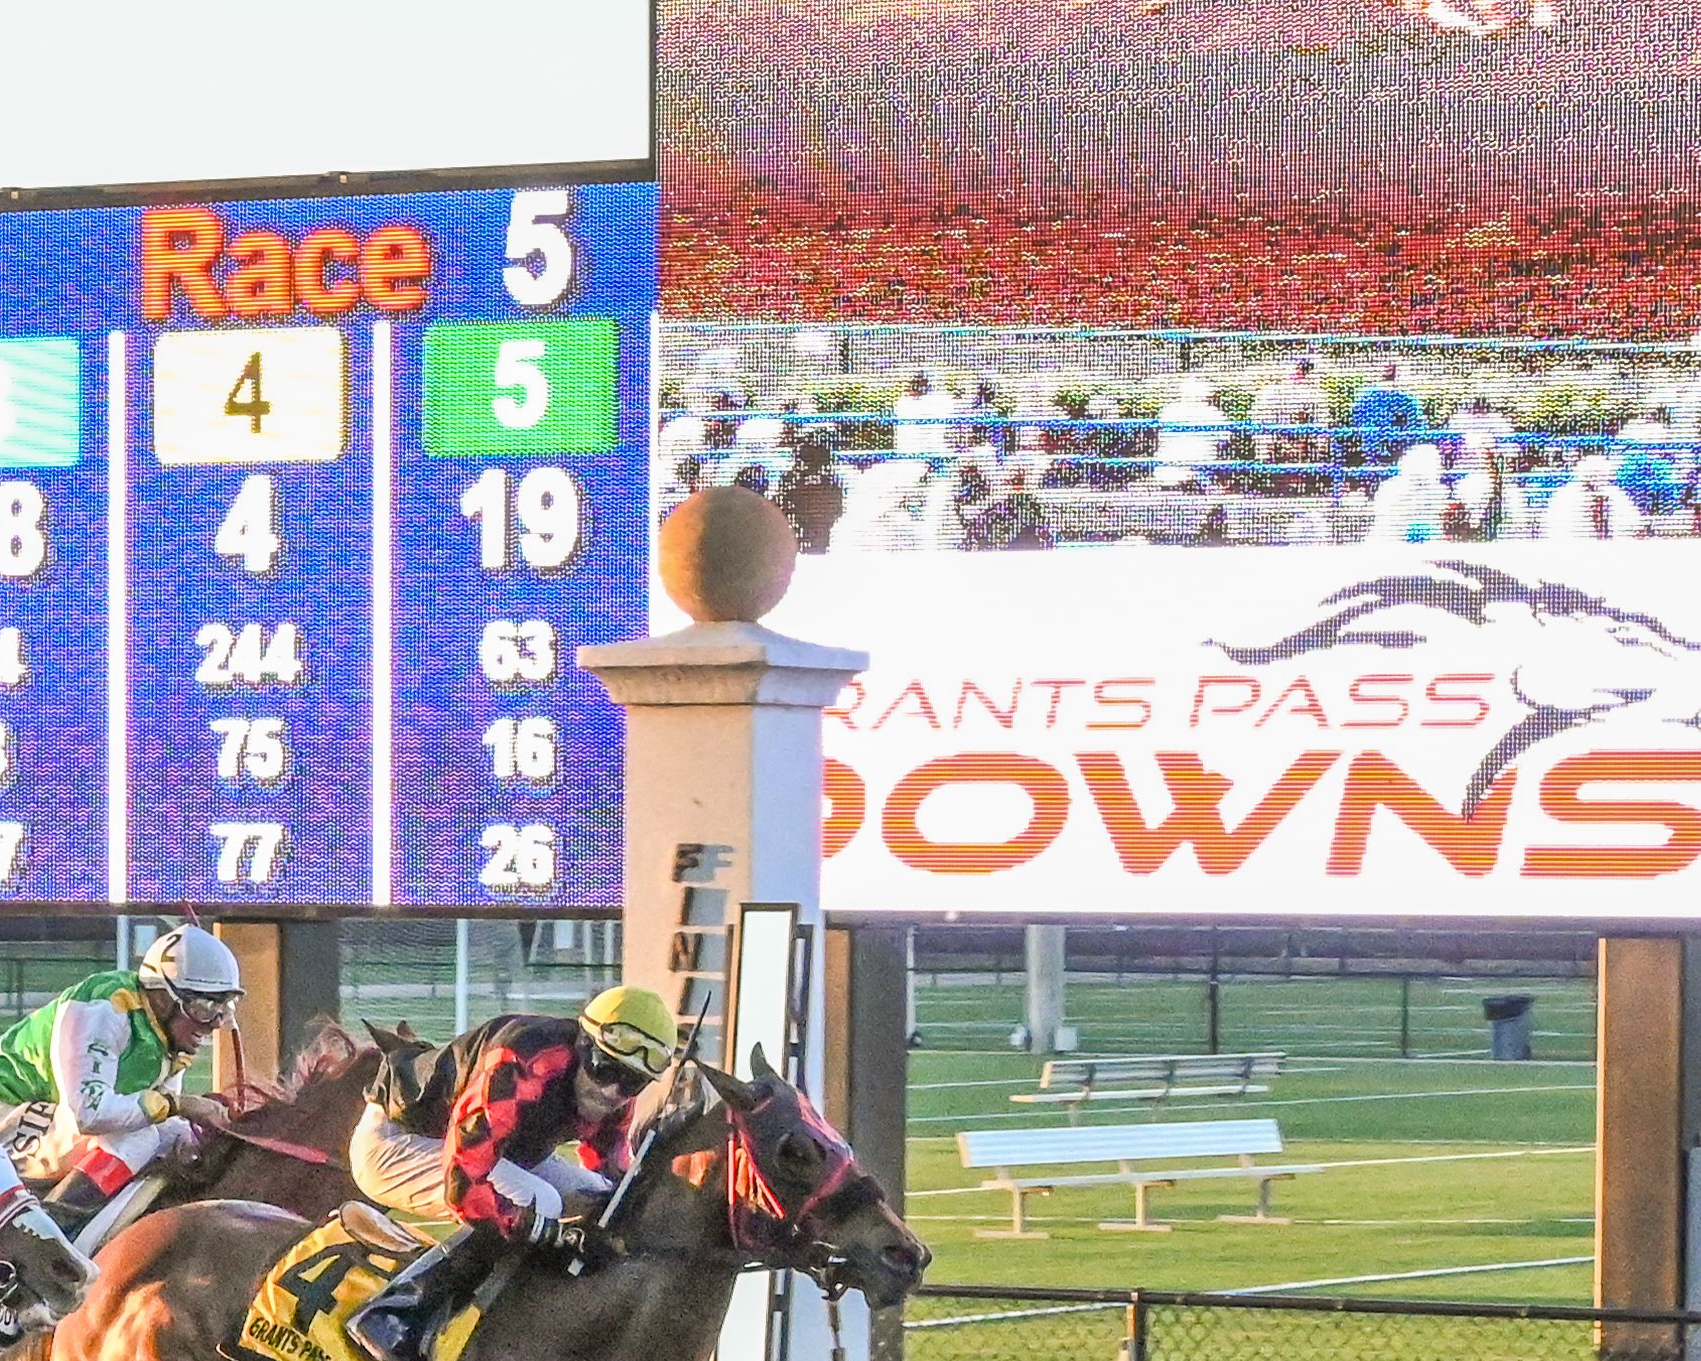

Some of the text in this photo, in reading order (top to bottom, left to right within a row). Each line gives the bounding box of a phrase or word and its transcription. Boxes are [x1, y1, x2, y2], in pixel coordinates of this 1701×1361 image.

[140, 190, 571, 320] Race 5
[223, 350, 272, 434] 4
[493, 340, 548, 428] 5
[216, 475, 278, 571] 4
[461, 467, 578, 568] 19
[196, 623, 302, 683] 244
[479, 621, 554, 680] 63
[822, 672, 1497, 731] RANTS PASS
[211, 718, 283, 778] 75
[483, 718, 554, 777] 16
[822, 749, 1701, 879] OWNS
[210, 823, 282, 883] 77
[480, 824, 553, 885] 26
[160, 933, 184, 964] 2
[248, 1316, 299, 1354] GRANTS
